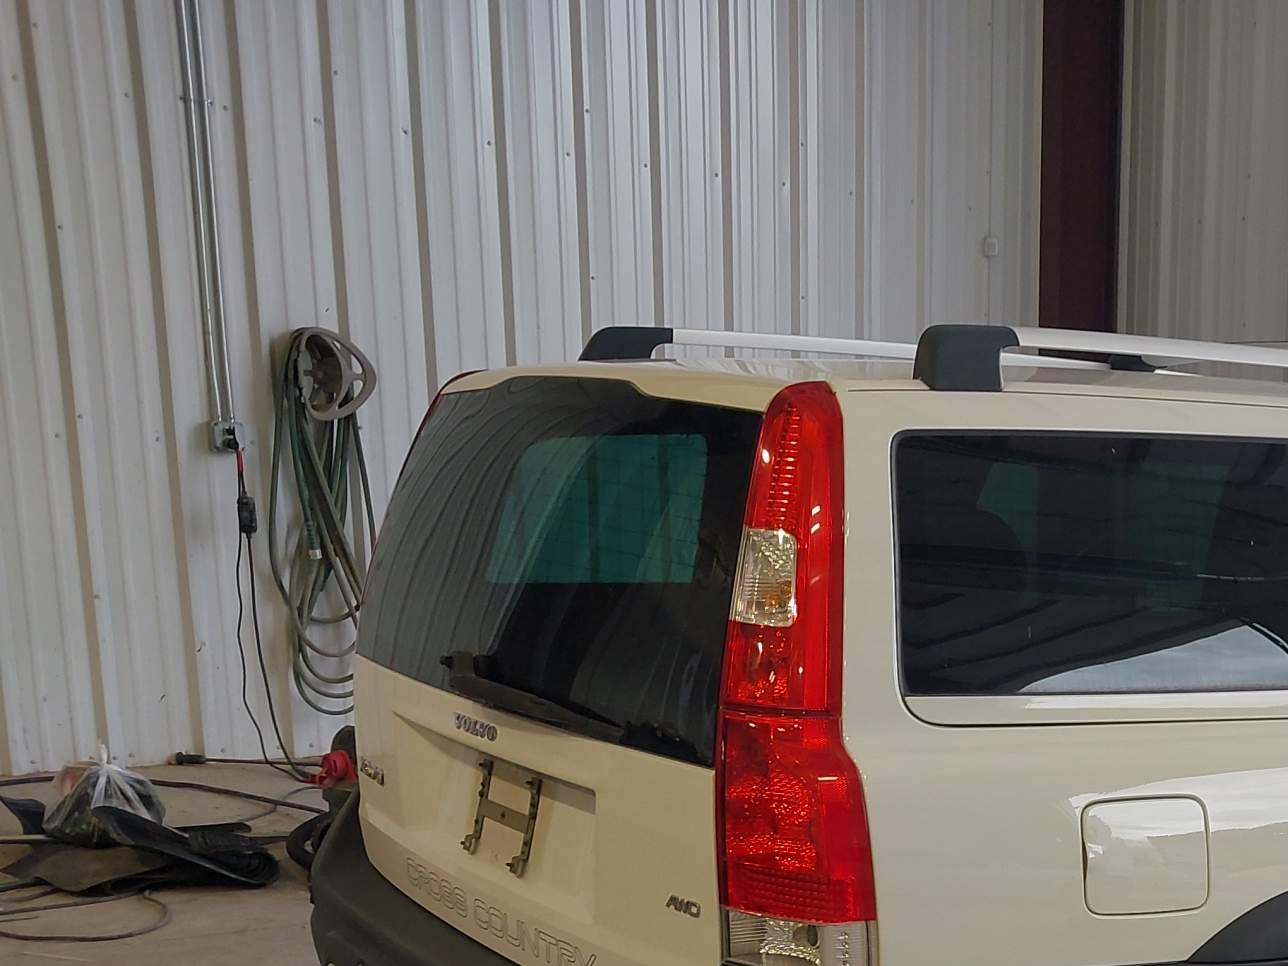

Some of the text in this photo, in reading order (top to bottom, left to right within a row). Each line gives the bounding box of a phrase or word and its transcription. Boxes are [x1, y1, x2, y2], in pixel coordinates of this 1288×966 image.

[454, 711, 498, 742] VOLVO
[406, 856, 468, 919] CROSS
[665, 894, 702, 919] AWD
